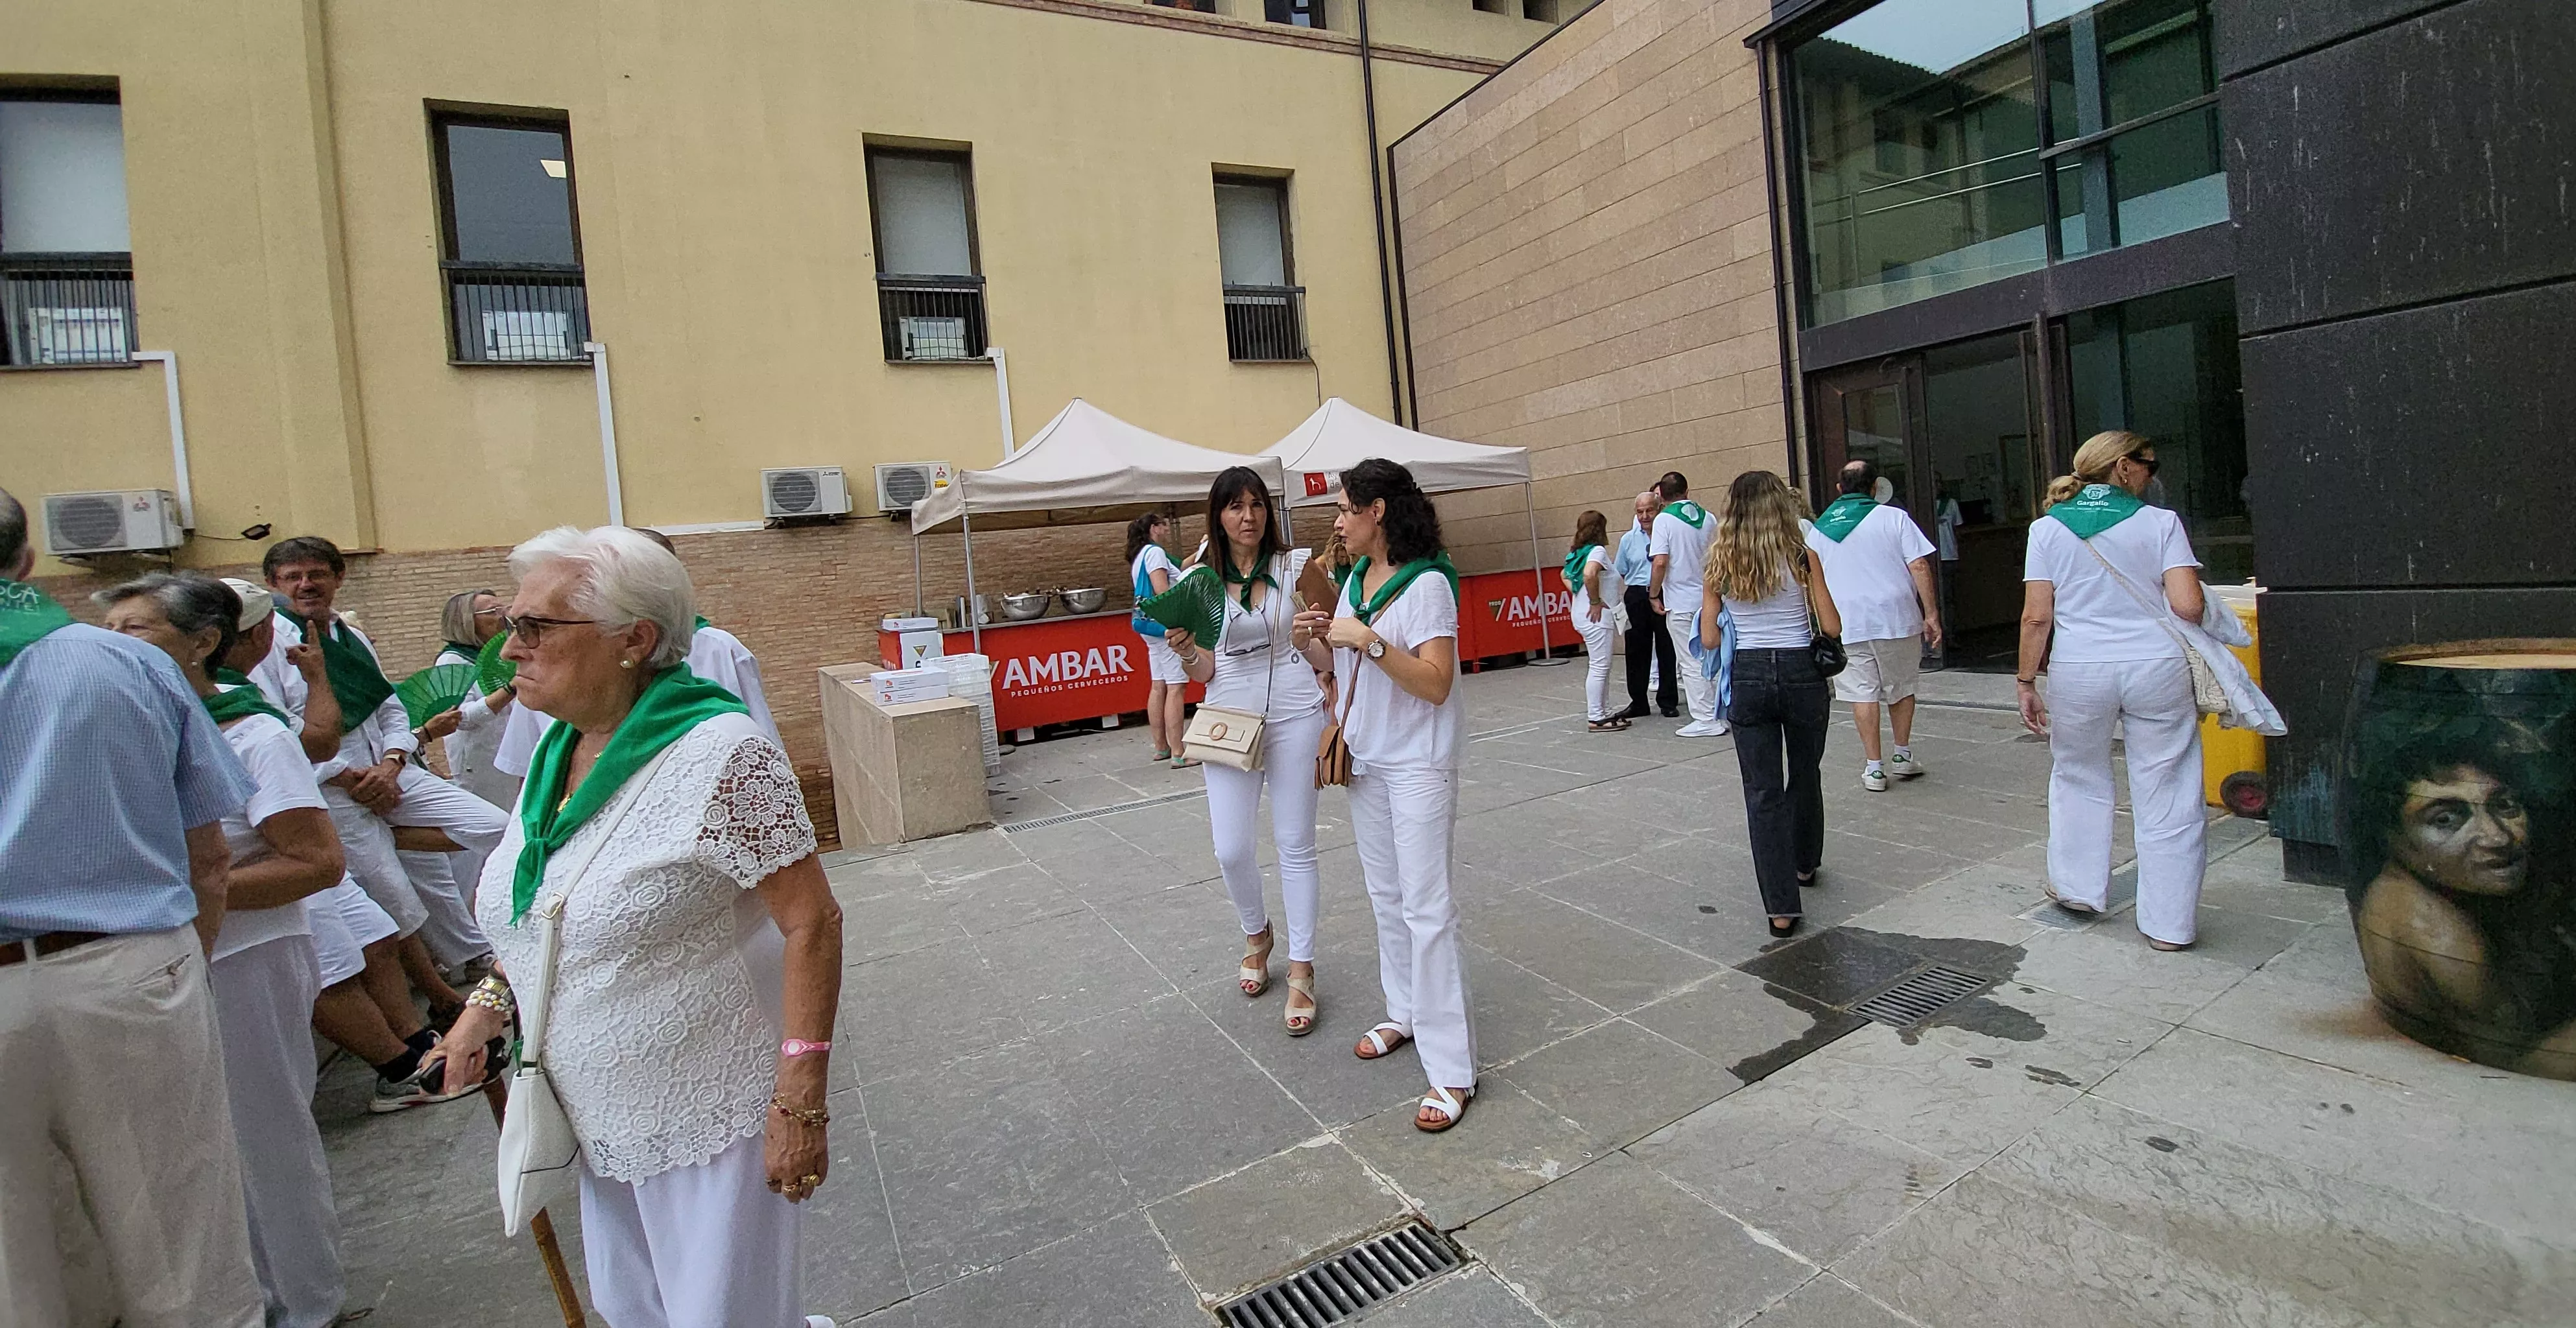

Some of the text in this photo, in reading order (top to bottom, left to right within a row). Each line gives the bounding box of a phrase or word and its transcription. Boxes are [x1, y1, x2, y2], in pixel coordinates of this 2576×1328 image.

[1328, 471, 1337, 480] Ay
[1507, 591, 1571, 621] AMBA
[1512, 619, 1542, 628] PEQUEÑO
[1002, 645, 1135, 689] AMBAR
[1010, 676, 1128, 698] PEQUEÑOS CERVECEROS
